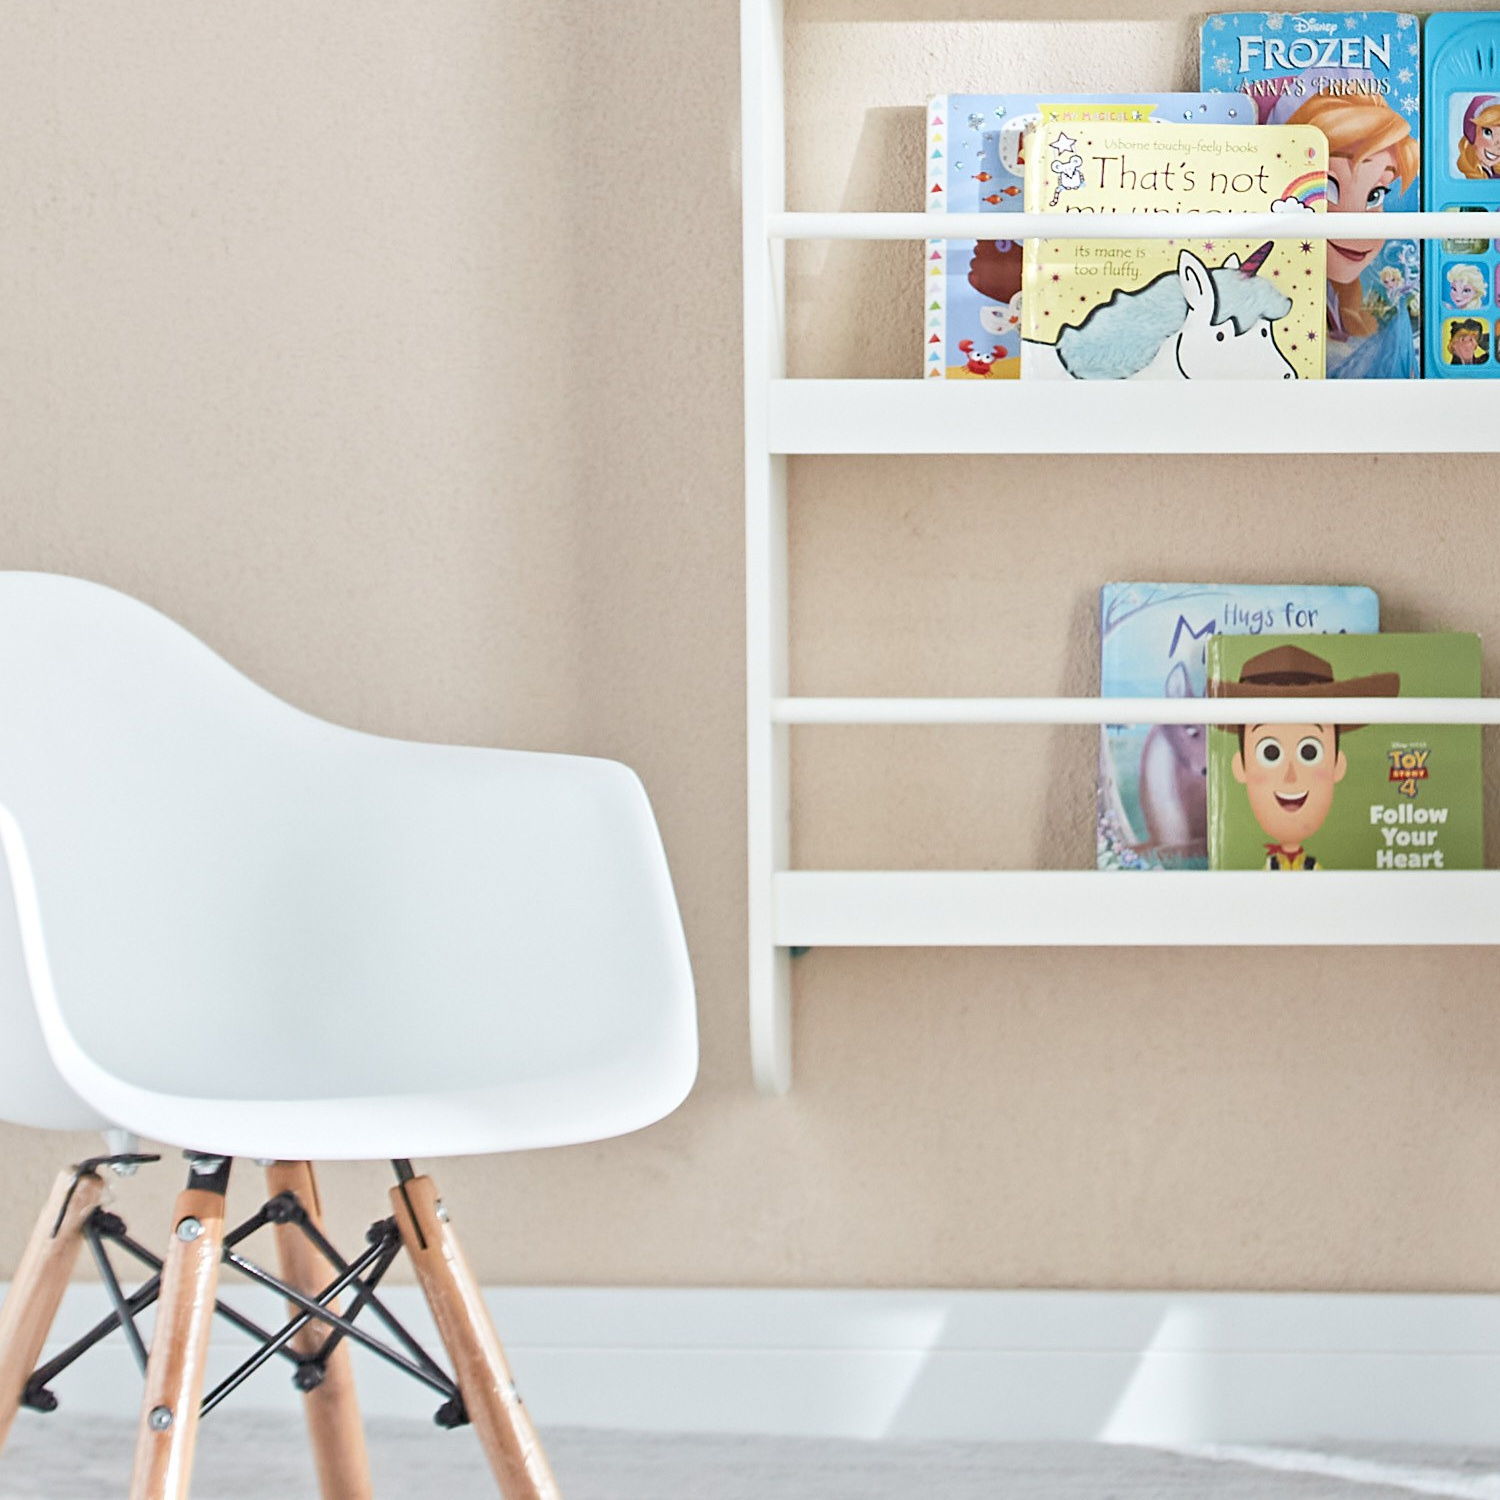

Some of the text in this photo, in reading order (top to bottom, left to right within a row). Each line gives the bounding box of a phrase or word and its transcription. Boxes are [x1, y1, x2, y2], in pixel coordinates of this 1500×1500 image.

[1291, 16, 1338, 36] Disney
[1238, 34, 1391, 73] FROZEN
[1235, 76, 1391, 97] ANNA'S FRIENDS
[1063, 111, 1129, 121] MY MAGICAL
[1104, 139, 1258, 156] Usborne touchy-feely books
[1092, 155, 1269, 193] That's not
[1095, 246, 1134, 258] mane
[1136, 245, 1146, 258] is
[1074, 261, 1143, 281] too fluffy.
[1223, 602, 1318, 635] Hugs for
[1388, 749, 1430, 769] TOY
[1399, 779, 1418, 798] 4
[1370, 803, 1448, 825] Follow
[1381, 827, 1438, 846] Your
[1376, 849, 1444, 868] Heart
